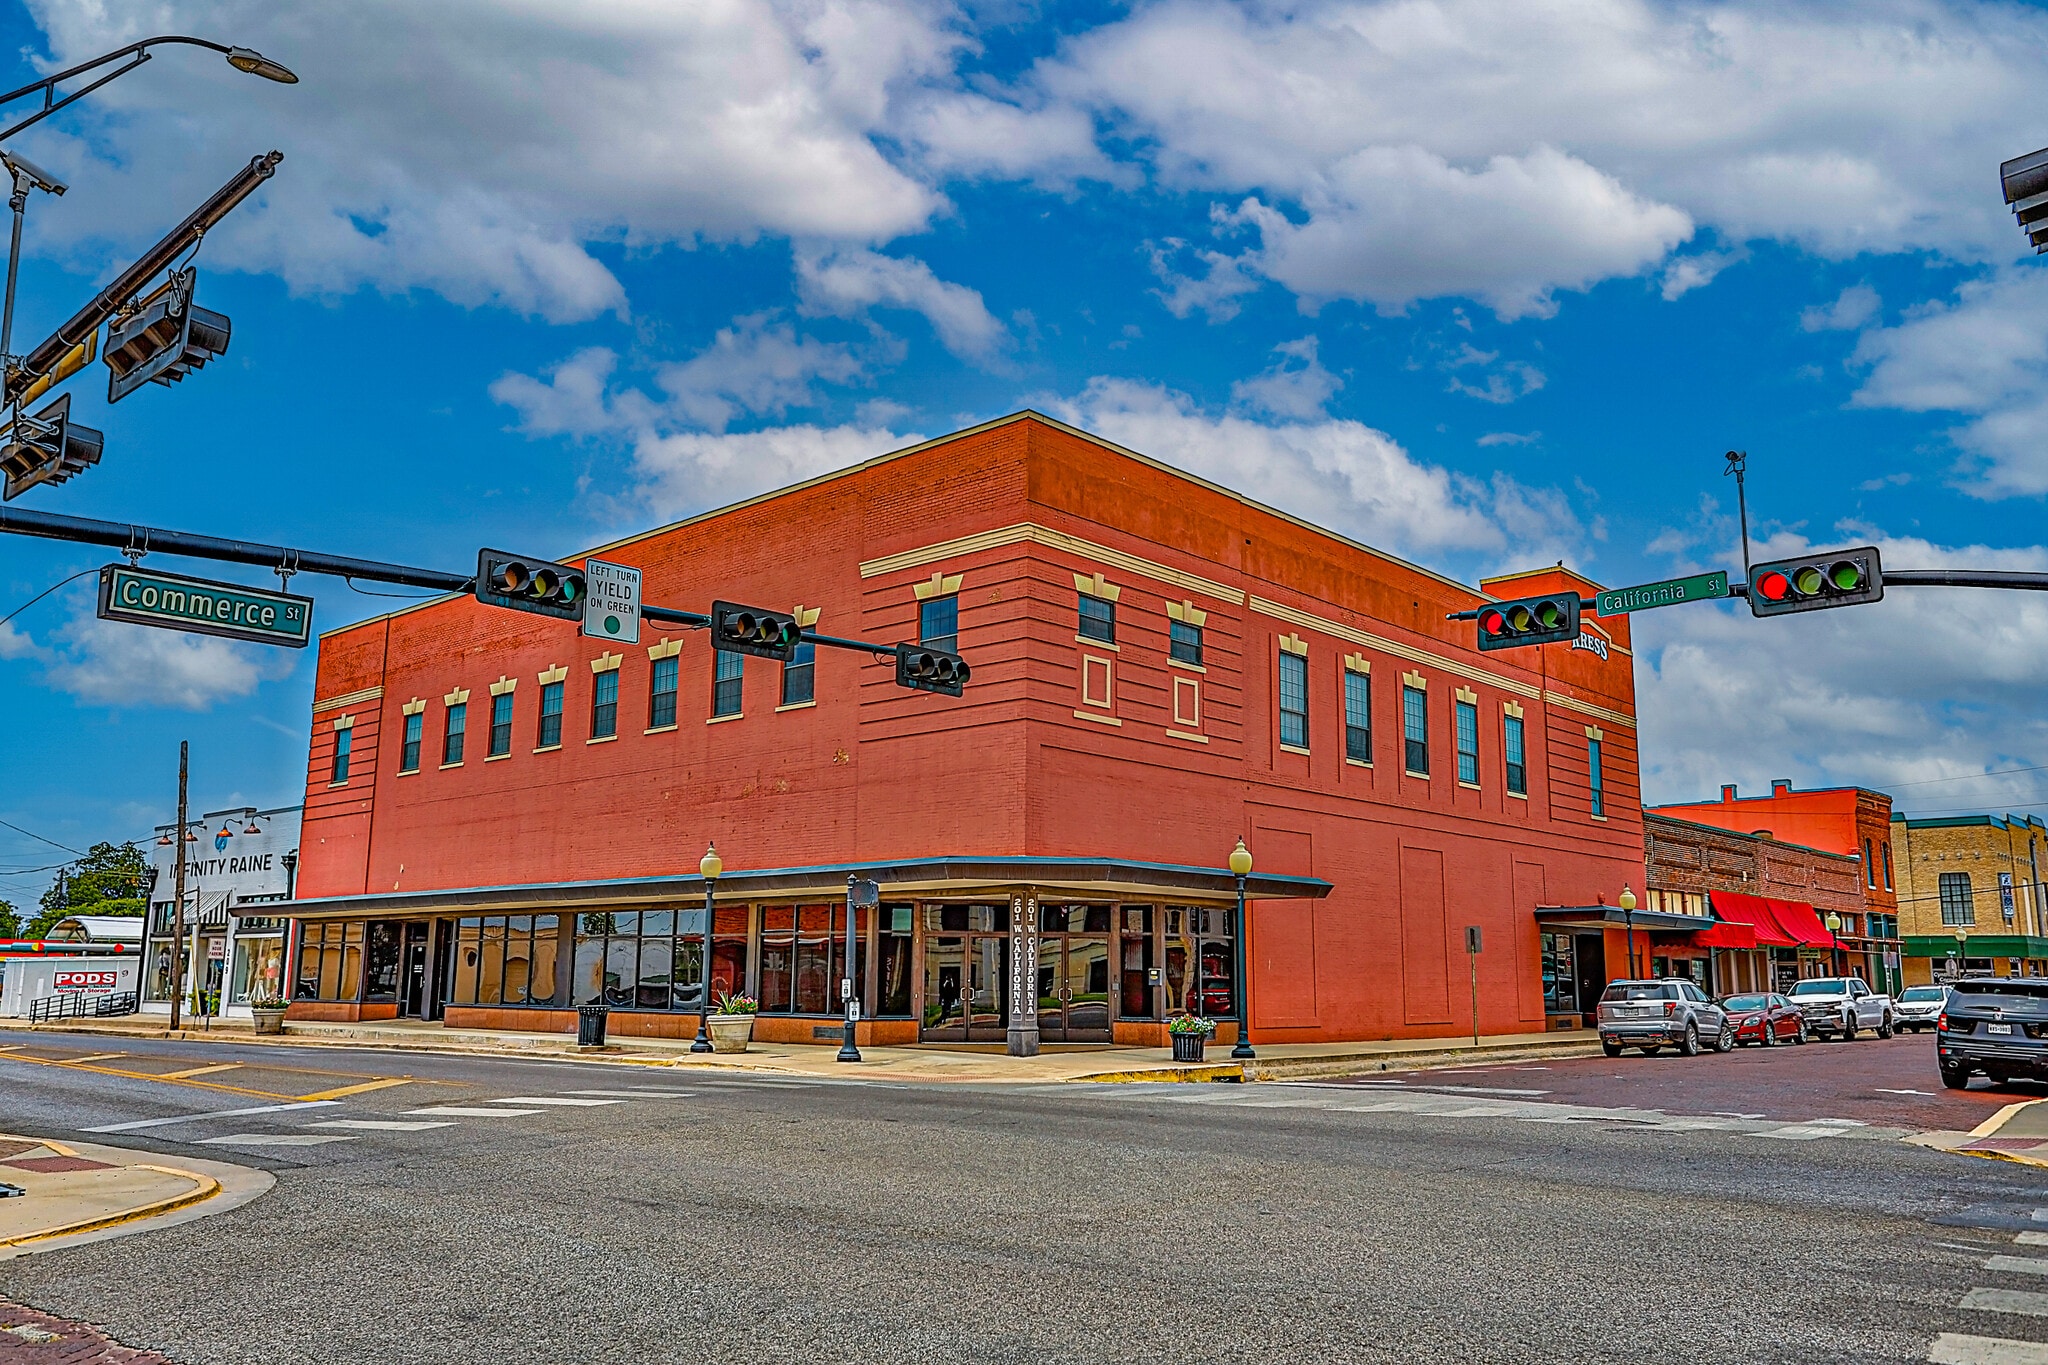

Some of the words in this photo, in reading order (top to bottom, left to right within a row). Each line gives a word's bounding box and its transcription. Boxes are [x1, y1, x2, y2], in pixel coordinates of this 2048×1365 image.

[591, 565, 610, 577] LEFT
[616, 570, 637, 583] TURN
[596, 580, 631, 600] YIELD
[1604, 584, 1685, 610] California
[1708, 579, 1720, 591] St
[122, 580, 275, 627] Commerce
[286, 607, 300, 620] St
[591, 597, 602, 608] ON
[607, 601, 634, 614] GREEN
[229, 854, 273, 874] RAINE
[1027, 898, 1035, 921] 201
[55, 973, 115, 984] PODS
[1013, 936, 1021, 1014] CALIFORNIA
[1027, 936, 1035, 1014] CALIFORNIA
